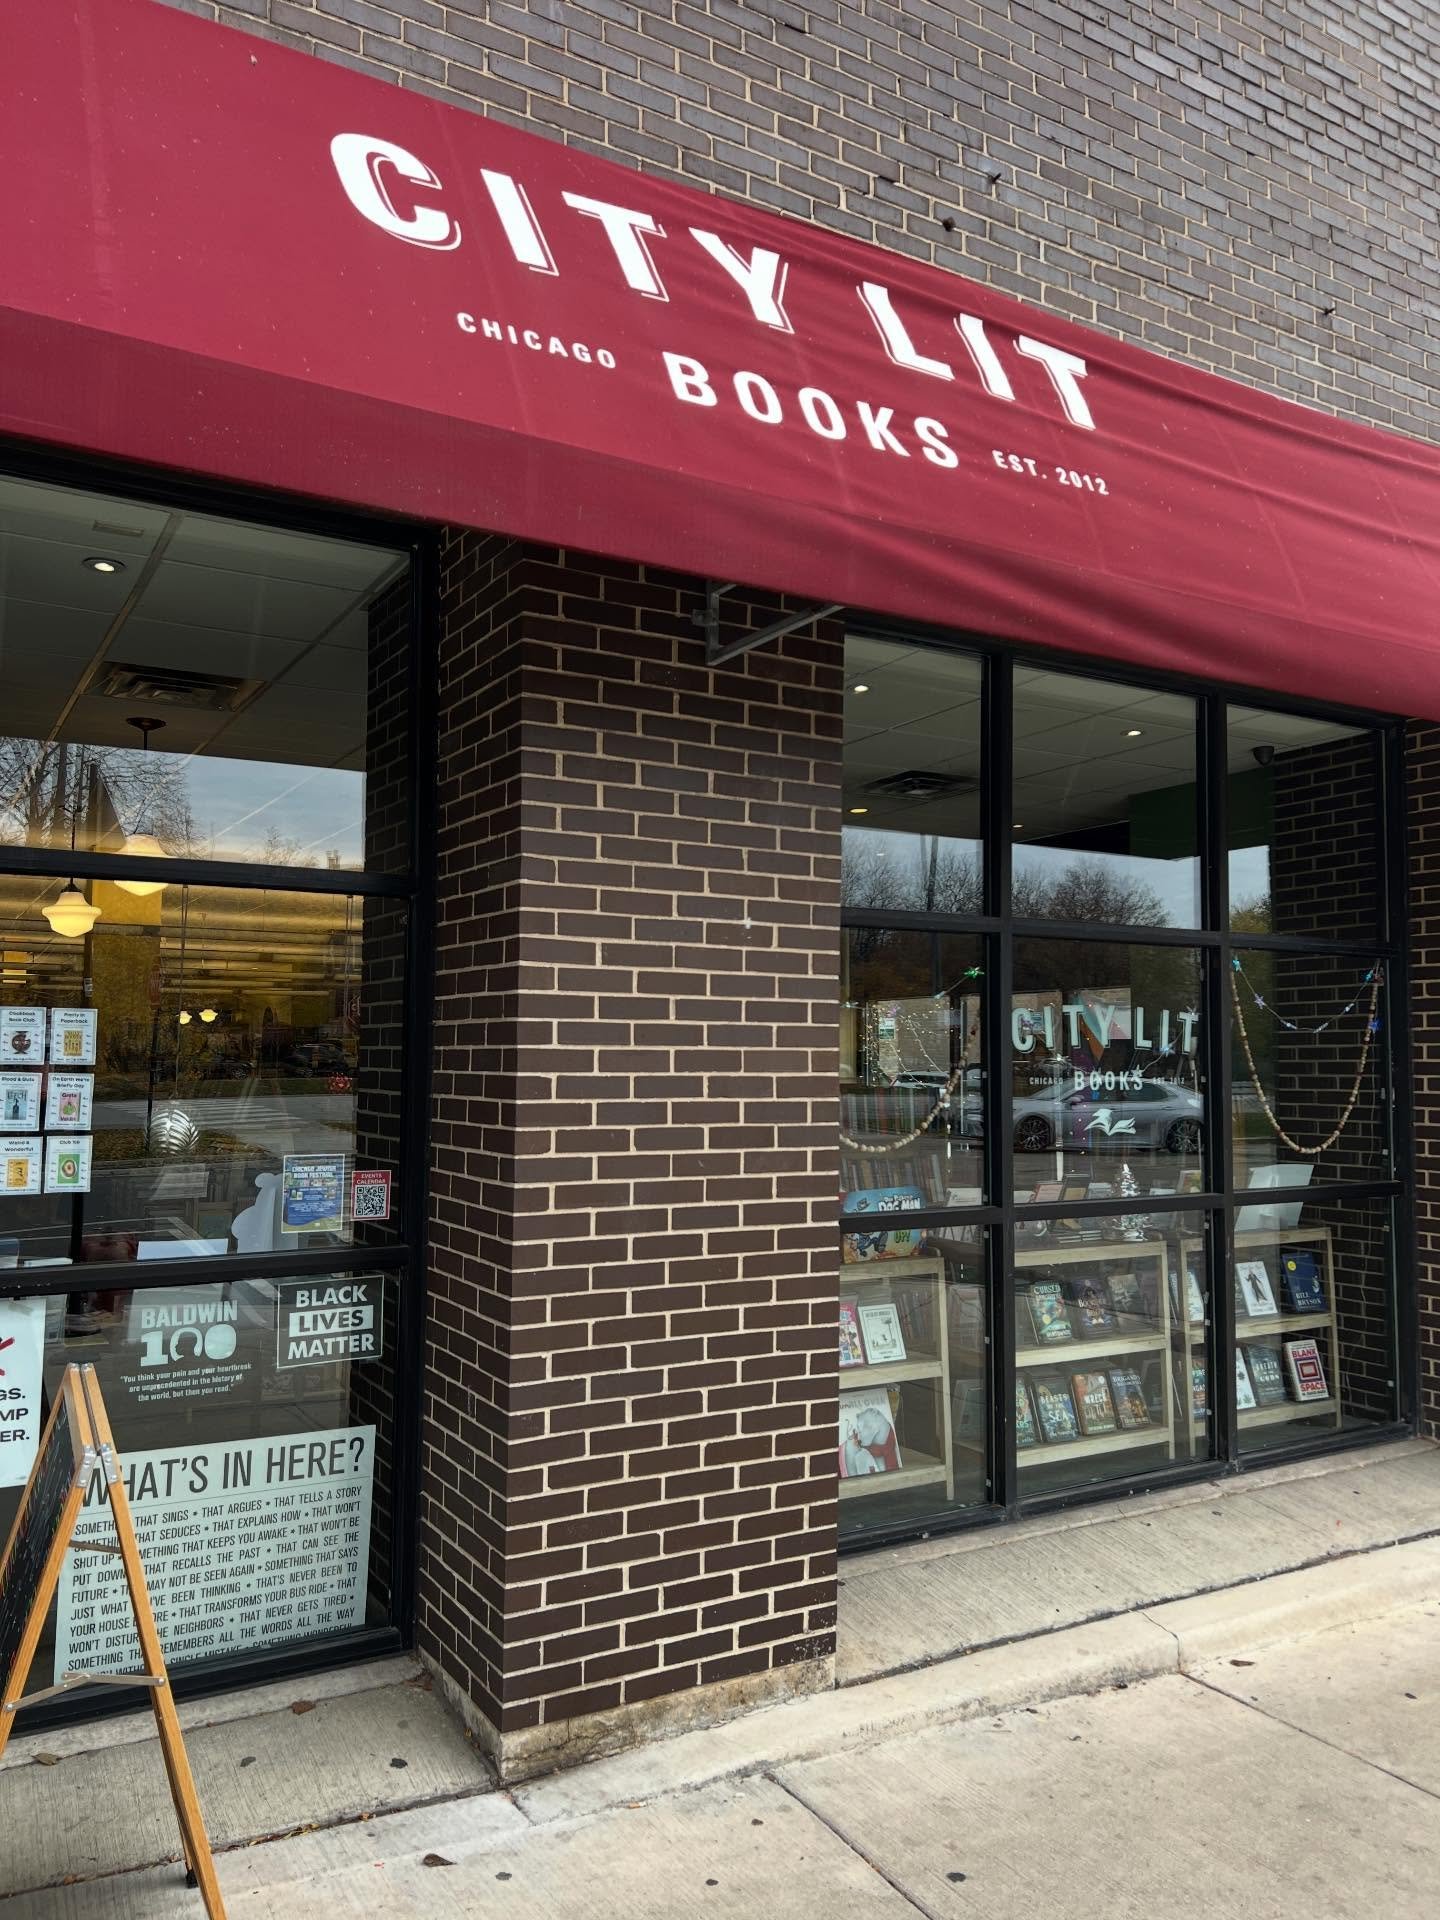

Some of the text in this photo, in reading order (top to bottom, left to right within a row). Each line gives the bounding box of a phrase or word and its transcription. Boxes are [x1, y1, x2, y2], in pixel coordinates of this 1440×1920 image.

[329, 132, 1097, 430] CITY LIT
[456, 311, 617, 370] CHICAGO
[662, 350, 959, 469] BOOKS
[991, 449, 1109, 496] EST. 2012
[1011, 1004, 1200, 1055] CITY LIT
[1074, 1070, 1143, 1091] BOOKS
[140, 1299, 238, 1329] BALDWIN
[295, 1284, 368, 1308] BLACK
[298, 1308, 365, 1332] LIVES
[287, 1333, 375, 1360] MATTER
[1291, 1348, 1317, 1358] BLANK
[137, 1373, 155, 1382] think
[156, 1372, 171, 1380] your
[172, 1369, 187, 1378] pain
[201, 1367, 216, 1375] your
[172, 1390, 184, 1398] but
[185, 1388, 200, 1397] then
[201, 1388, 213, 1396] you
[192, 1377, 199, 1385] in
[200, 1376, 211, 1384] the
[1299, 1382, 1326, 1392] SPACE
[1048, 1410, 1069, 1421] SEA
[222, 1449, 252, 1489] IN
[266, 1436, 365, 1484] HERE?
[75, 1485, 362, 1536] SOMETH THAT SINGS THAT ARGUES THAT TELLS A STORY
[159, 1524, 201, 1540] SEDUCES
[213, 1519, 234, 1533] THAT
[237, 1513, 278, 1529] EXPLAINS
[281, 1509, 301, 1523] HOW
[312, 1505, 333, 1518] THAT
[335, 1500, 361, 1514] WON'T
[72, 1531, 360, 1587] PUT DOWN THAT RECALLS THE PAST THAT CAN SEE THE
[73, 1515, 360, 1570] SHUT UP METHING THAT KEEPS YOU AWAKE THAT WON'T BE
[70, 1606, 95, 1621] JUST
[101, 1601, 128, 1616] WHAT
[171, 1590, 196, 1604] BEEN
[201, 1582, 241, 1599] THINKING
[256, 1574, 285, 1589] THAT'S
[289, 1569, 317, 1583] NEVER
[321, 1565, 343, 1578] BEEN
[347, 1561, 358, 1573] TO
[71, 1588, 109, 1604] FUTURE
[146, 1578, 167, 1591] MAY
[168, 1574, 187, 1588] NOT
[189, 1572, 201, 1584] BE
[204, 1567, 227, 1582] SEEN
[229, 1563, 255, 1578] AGAIN
[264, 1554, 313, 1572] SOMETHING
[316, 1550, 336, 1563] THAT
[338, 1546, 359, 1560] SAYS
[69, 1639, 100, 1655] WON'T
[105, 1632, 139, 1649] DISTUR
[157, 1626, 169, 1639] HE
[173, 1616, 225, 1637] NEIGHBORS
[239, 1609, 262, 1623] THAT
[265, 1604, 293, 1619] NEVER
[297, 1599, 319, 1612] GETS
[322, 1594, 347, 1608] TIRED
[70, 1623, 96, 1638] YOUR
[98, 1617, 130, 1633] HOUSE
[179, 1604, 202, 1619] THAT
[204, 1593, 262, 1612] TRANSFORMS
[264, 1589, 287, 1603] YOUR
[289, 1586, 307, 1599] BUS
[308, 1582, 328, 1595] RIDE
[337, 1576, 357, 1590] THAT
[67, 1651, 124, 1672] SOMETHING
[160, 1634, 215, 1654] REMEMBERS
[218, 1630, 235, 1644] ALL
[240, 1625, 257, 1640] THE
[261, 1619, 293, 1635] WORDS
[296, 1615, 312, 1628] ALL
[316, 1611, 333, 1625] THE
[336, 1607, 356, 1620] WAY
